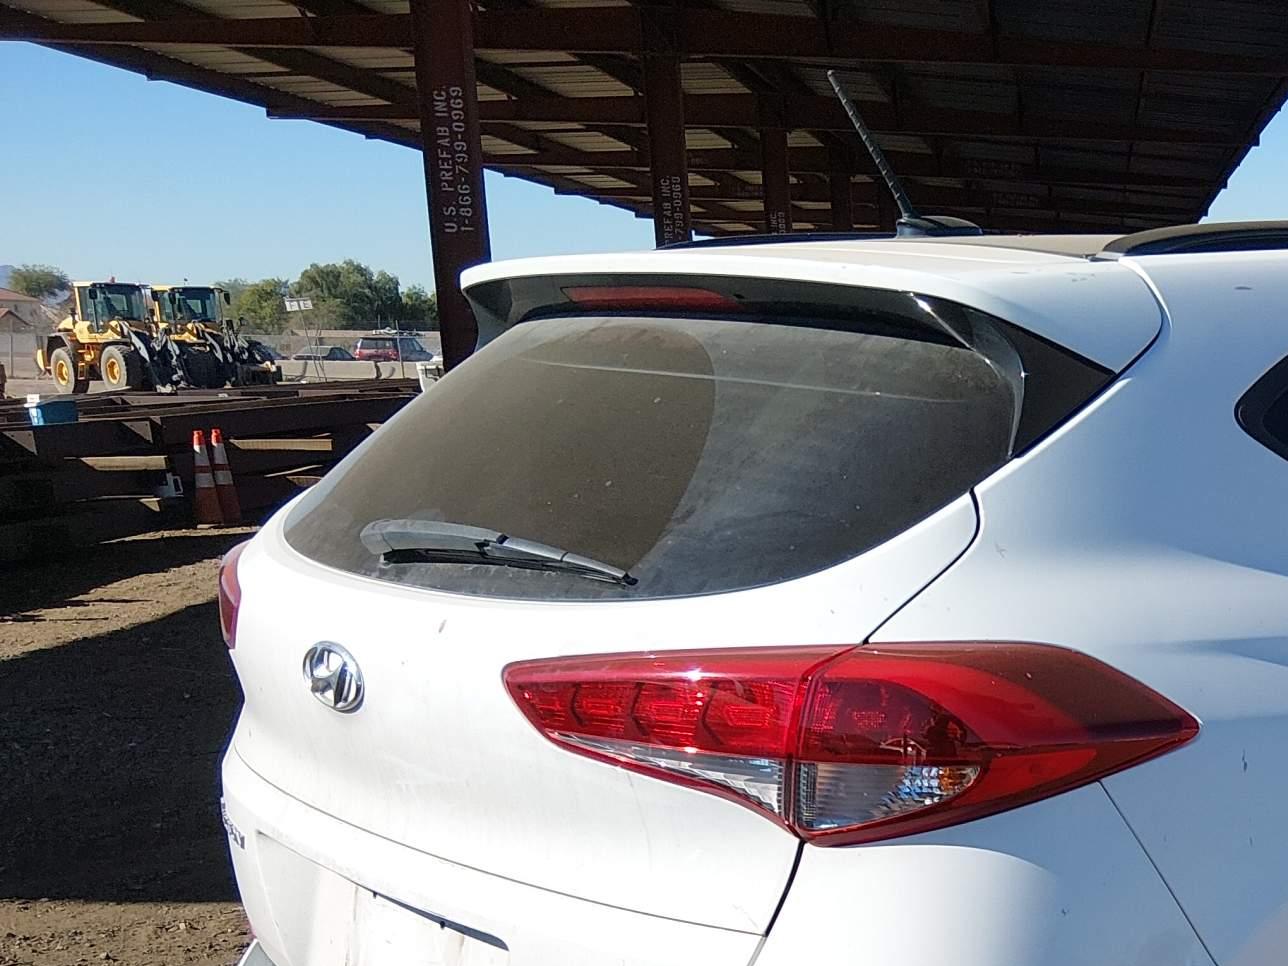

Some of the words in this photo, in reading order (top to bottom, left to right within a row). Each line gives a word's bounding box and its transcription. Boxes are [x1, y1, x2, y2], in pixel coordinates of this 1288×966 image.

[433, 86, 448, 117] INC.
[436, 126, 454, 191] PREFAB
[450, 87, 475, 231] 1-866-799-0969
[444, 201, 458, 233] U.S.
